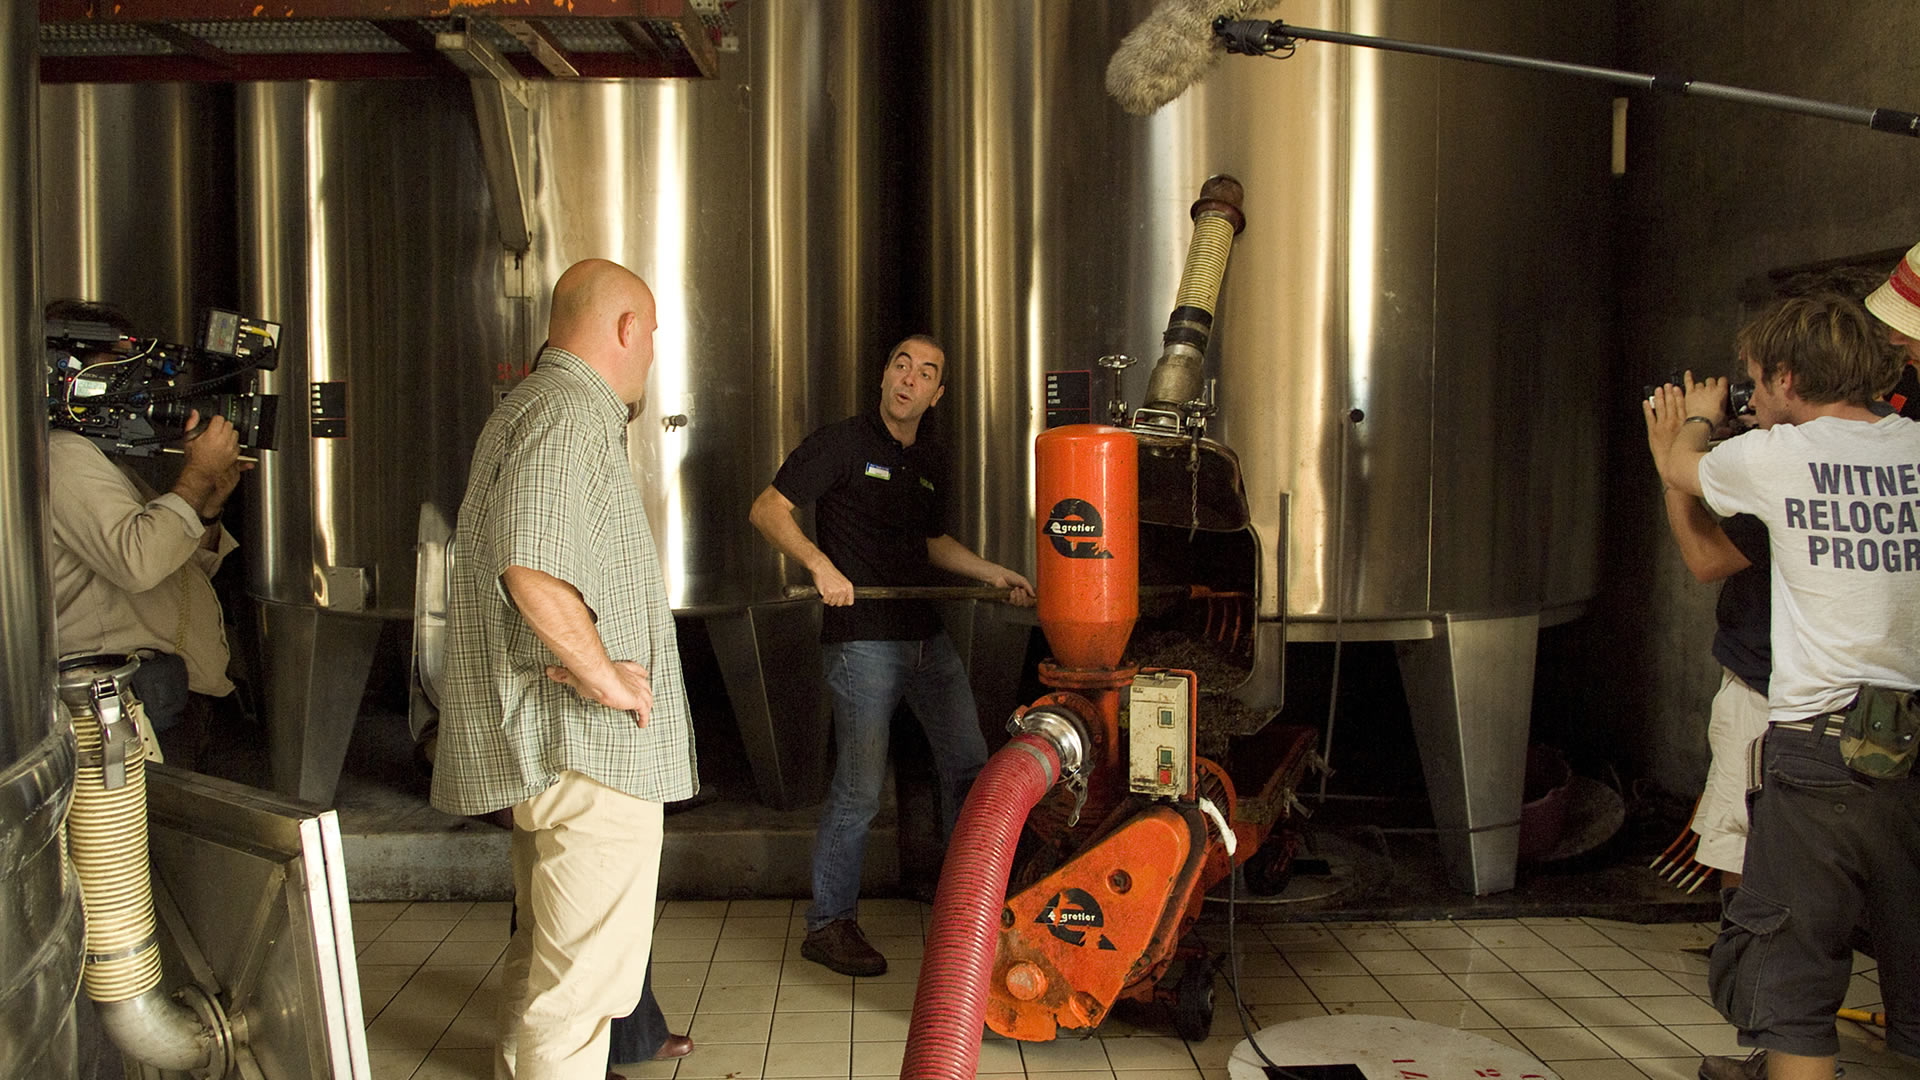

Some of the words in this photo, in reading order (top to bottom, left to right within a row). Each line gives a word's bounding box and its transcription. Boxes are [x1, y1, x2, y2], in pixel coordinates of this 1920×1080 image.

[1808, 462, 1920, 496] WITNE
[1785, 498, 1920, 534] RELOCA
[1808, 535, 1920, 572] PROGR
